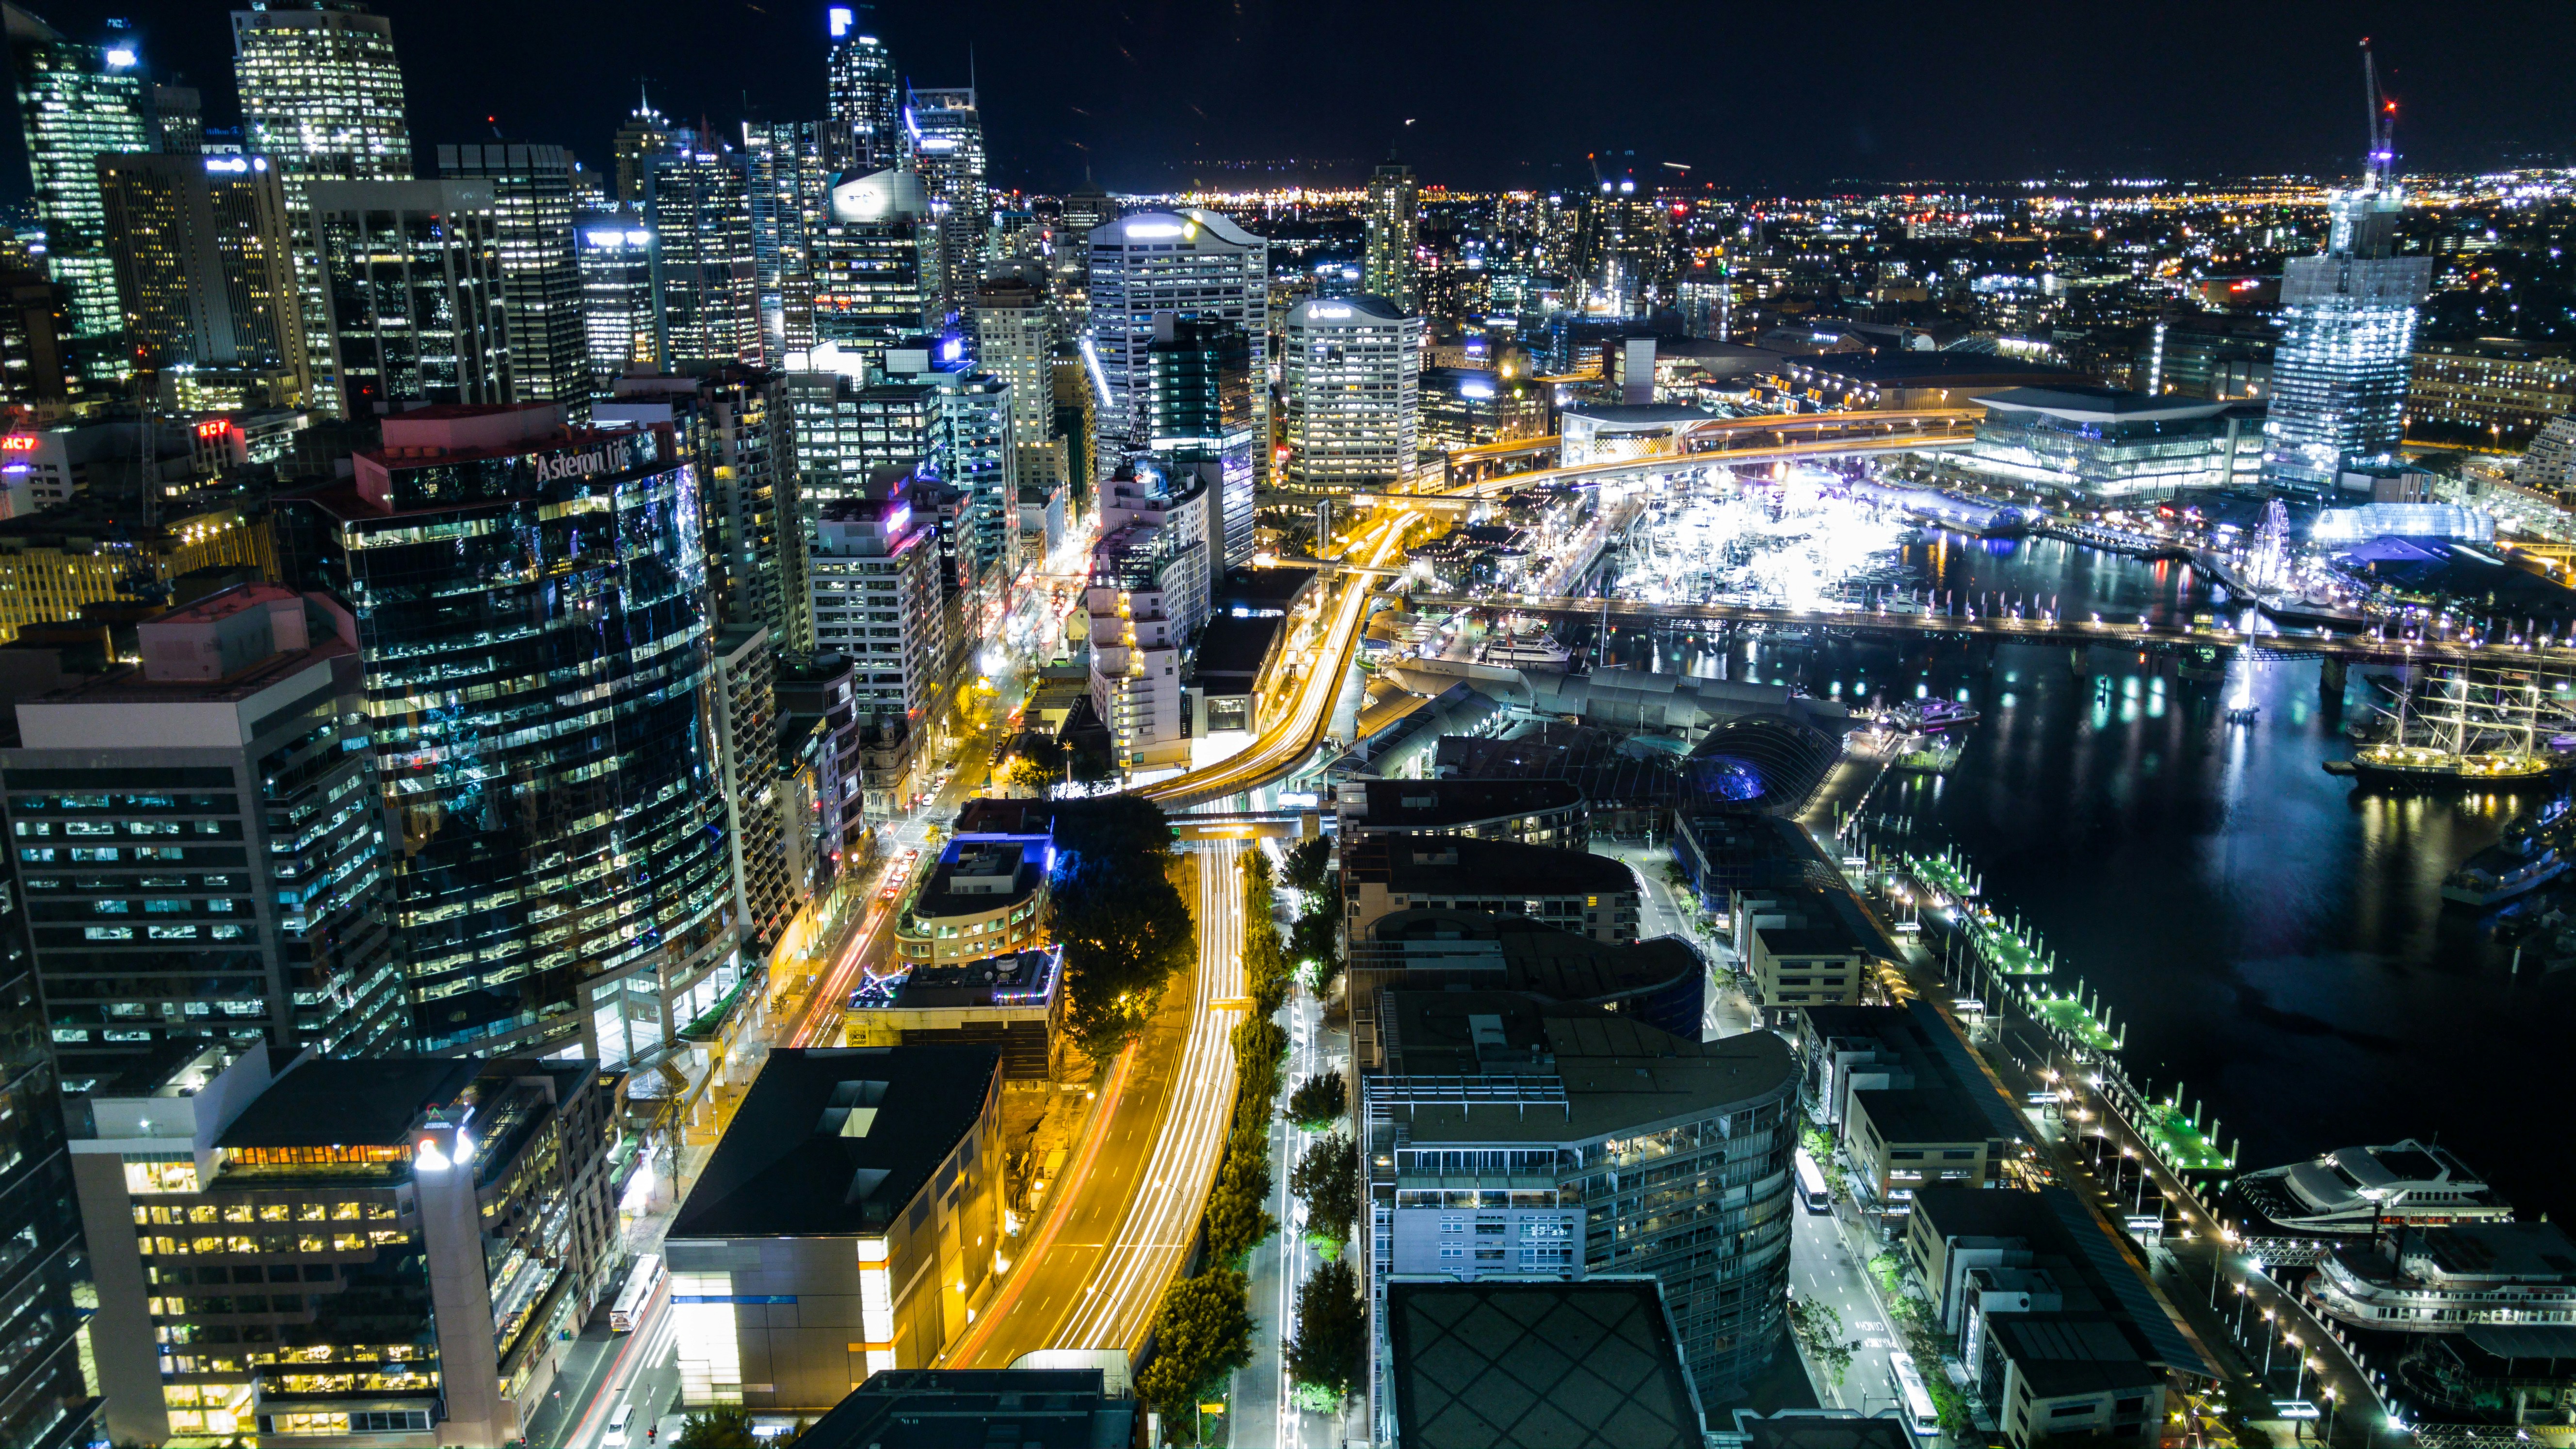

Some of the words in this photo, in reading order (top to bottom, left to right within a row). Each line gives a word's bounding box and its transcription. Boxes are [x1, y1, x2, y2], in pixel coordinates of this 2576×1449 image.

[537, 451, 604, 483] Asteron
[607, 438, 631, 470] Life
[1859, 1321, 1884, 1331] COACH
